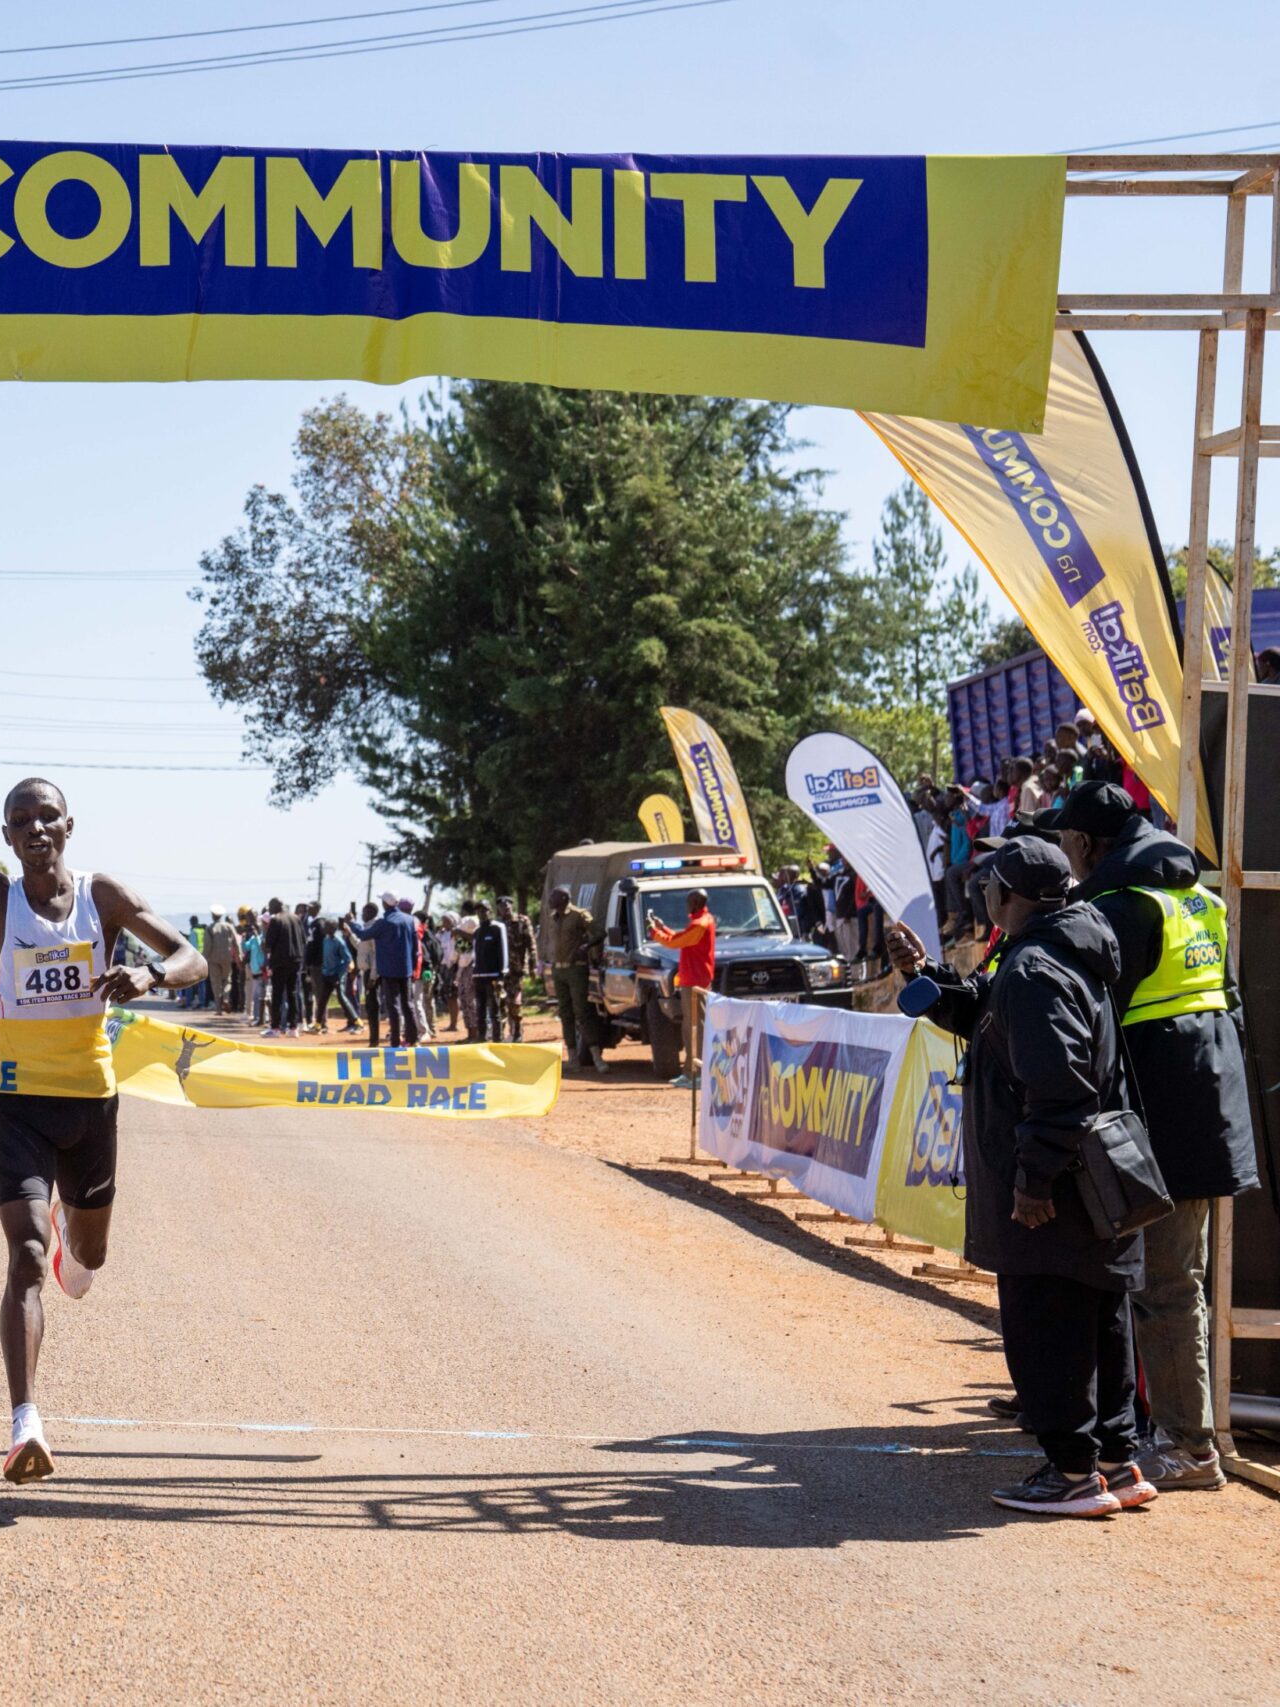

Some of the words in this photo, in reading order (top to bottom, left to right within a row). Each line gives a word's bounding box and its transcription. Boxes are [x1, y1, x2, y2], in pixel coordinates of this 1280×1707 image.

[1186, 943, 1221, 968] 29090
[25, 965, 81, 994] 488
[336, 1046, 450, 1080] ITEN
[297, 1081, 392, 1106] ROAD
[407, 1083, 487, 1111] RACE
